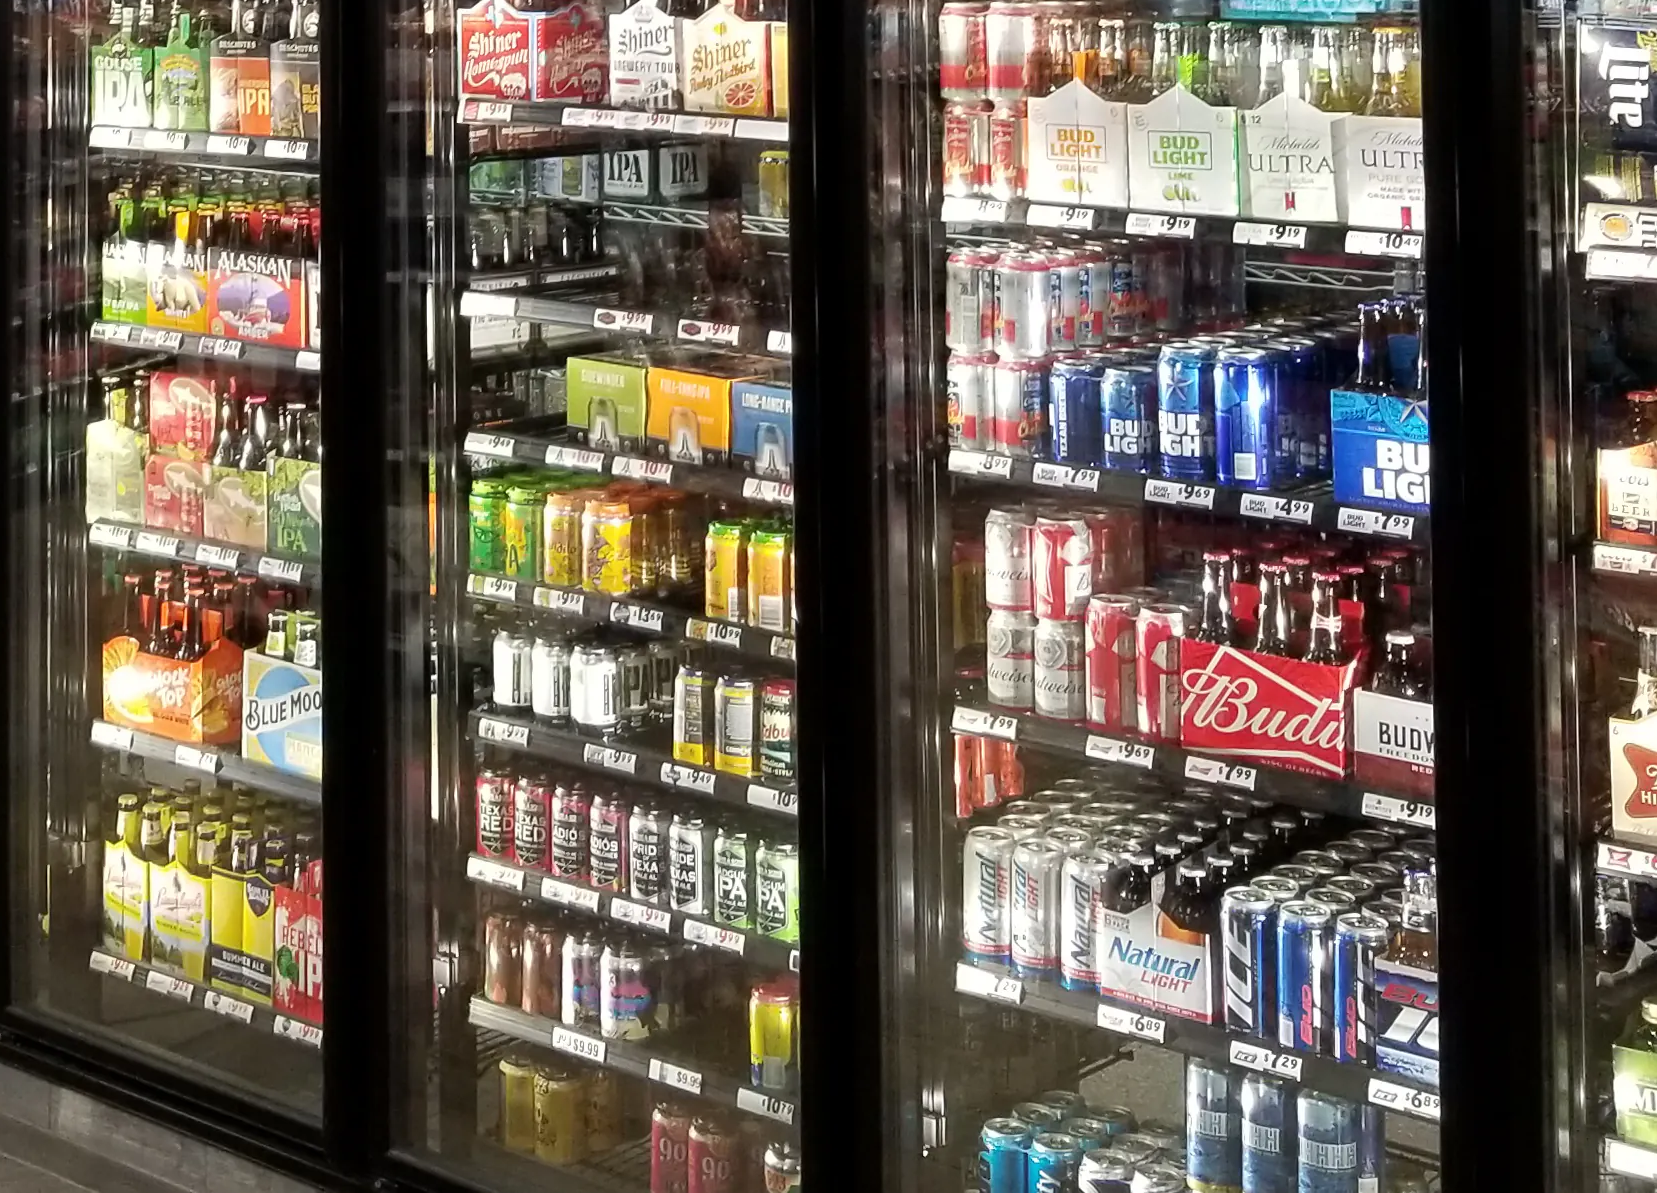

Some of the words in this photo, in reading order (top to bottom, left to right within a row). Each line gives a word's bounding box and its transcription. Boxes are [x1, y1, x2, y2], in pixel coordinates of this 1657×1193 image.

[469, 30, 522, 58] Shiner
[618, 24, 675, 56] Shiner
[94, 55, 142, 72] GOOSE
[691, 38, 752, 75] Shiner
[614, 60, 653, 74] BREWERY
[1599, 41, 1650, 129] Lite
[240, 88, 270, 115] IPA
[1251, 115, 1262, 124] 12
[1057, 128, 1095, 143] BUD
[1159, 135, 1200, 150] BUD
[1050, 143, 1102, 158] LIGHT
[1153, 150, 1208, 165] LIGHT
[607, 153, 644, 184] IPA
[671, 152, 699, 184] IPA
[1056, 164, 1099, 174] ORANGE
[1248, 154, 1335, 174] ULTRA
[1168, 171, 1194, 181] LIME
[1160, 216, 1190, 231] $919
[1269, 224, 1300, 240] $919
[1379, 232, 1420, 250] $1049
[215, 251, 292, 287] ALASKAN
[1104, 434, 1154, 455] LIGH
[1377, 439, 1430, 472] BU
[772, 482, 793, 498] $10
[1363, 467, 1430, 504] LIG
[1275, 500, 1310, 515] $499
[1374, 515, 1411, 530] $799
[277, 526, 307, 552] IPA
[157, 687, 186, 708] TOP
[226, 685, 242, 702] TO
[246, 698, 286, 730] BLUE
[291, 690, 322, 717] MOO
[1219, 766, 1252, 780] $799
[1641, 791, 1657, 806] HI
[481, 805, 514, 816] TEXAS
[1399, 803, 1433, 820] $919
[480, 816, 514, 832] RED
[515, 824, 546, 842] RED
[283, 926, 322, 956] REBEL
[223, 950, 251, 966] SUMMER
[252, 960, 265, 973] ALE
[1109, 936, 1200, 981] Natural
[298, 951, 322, 1001] IP
[1141, 970, 1192, 993] LIGHT
[1226, 925, 1253, 1030] ICE
[1381, 984, 1438, 1010] BU
[1130, 1018, 1161, 1033] $689
[573, 1037, 599, 1058] $9.99
[1263, 1053, 1298, 1069] $729
